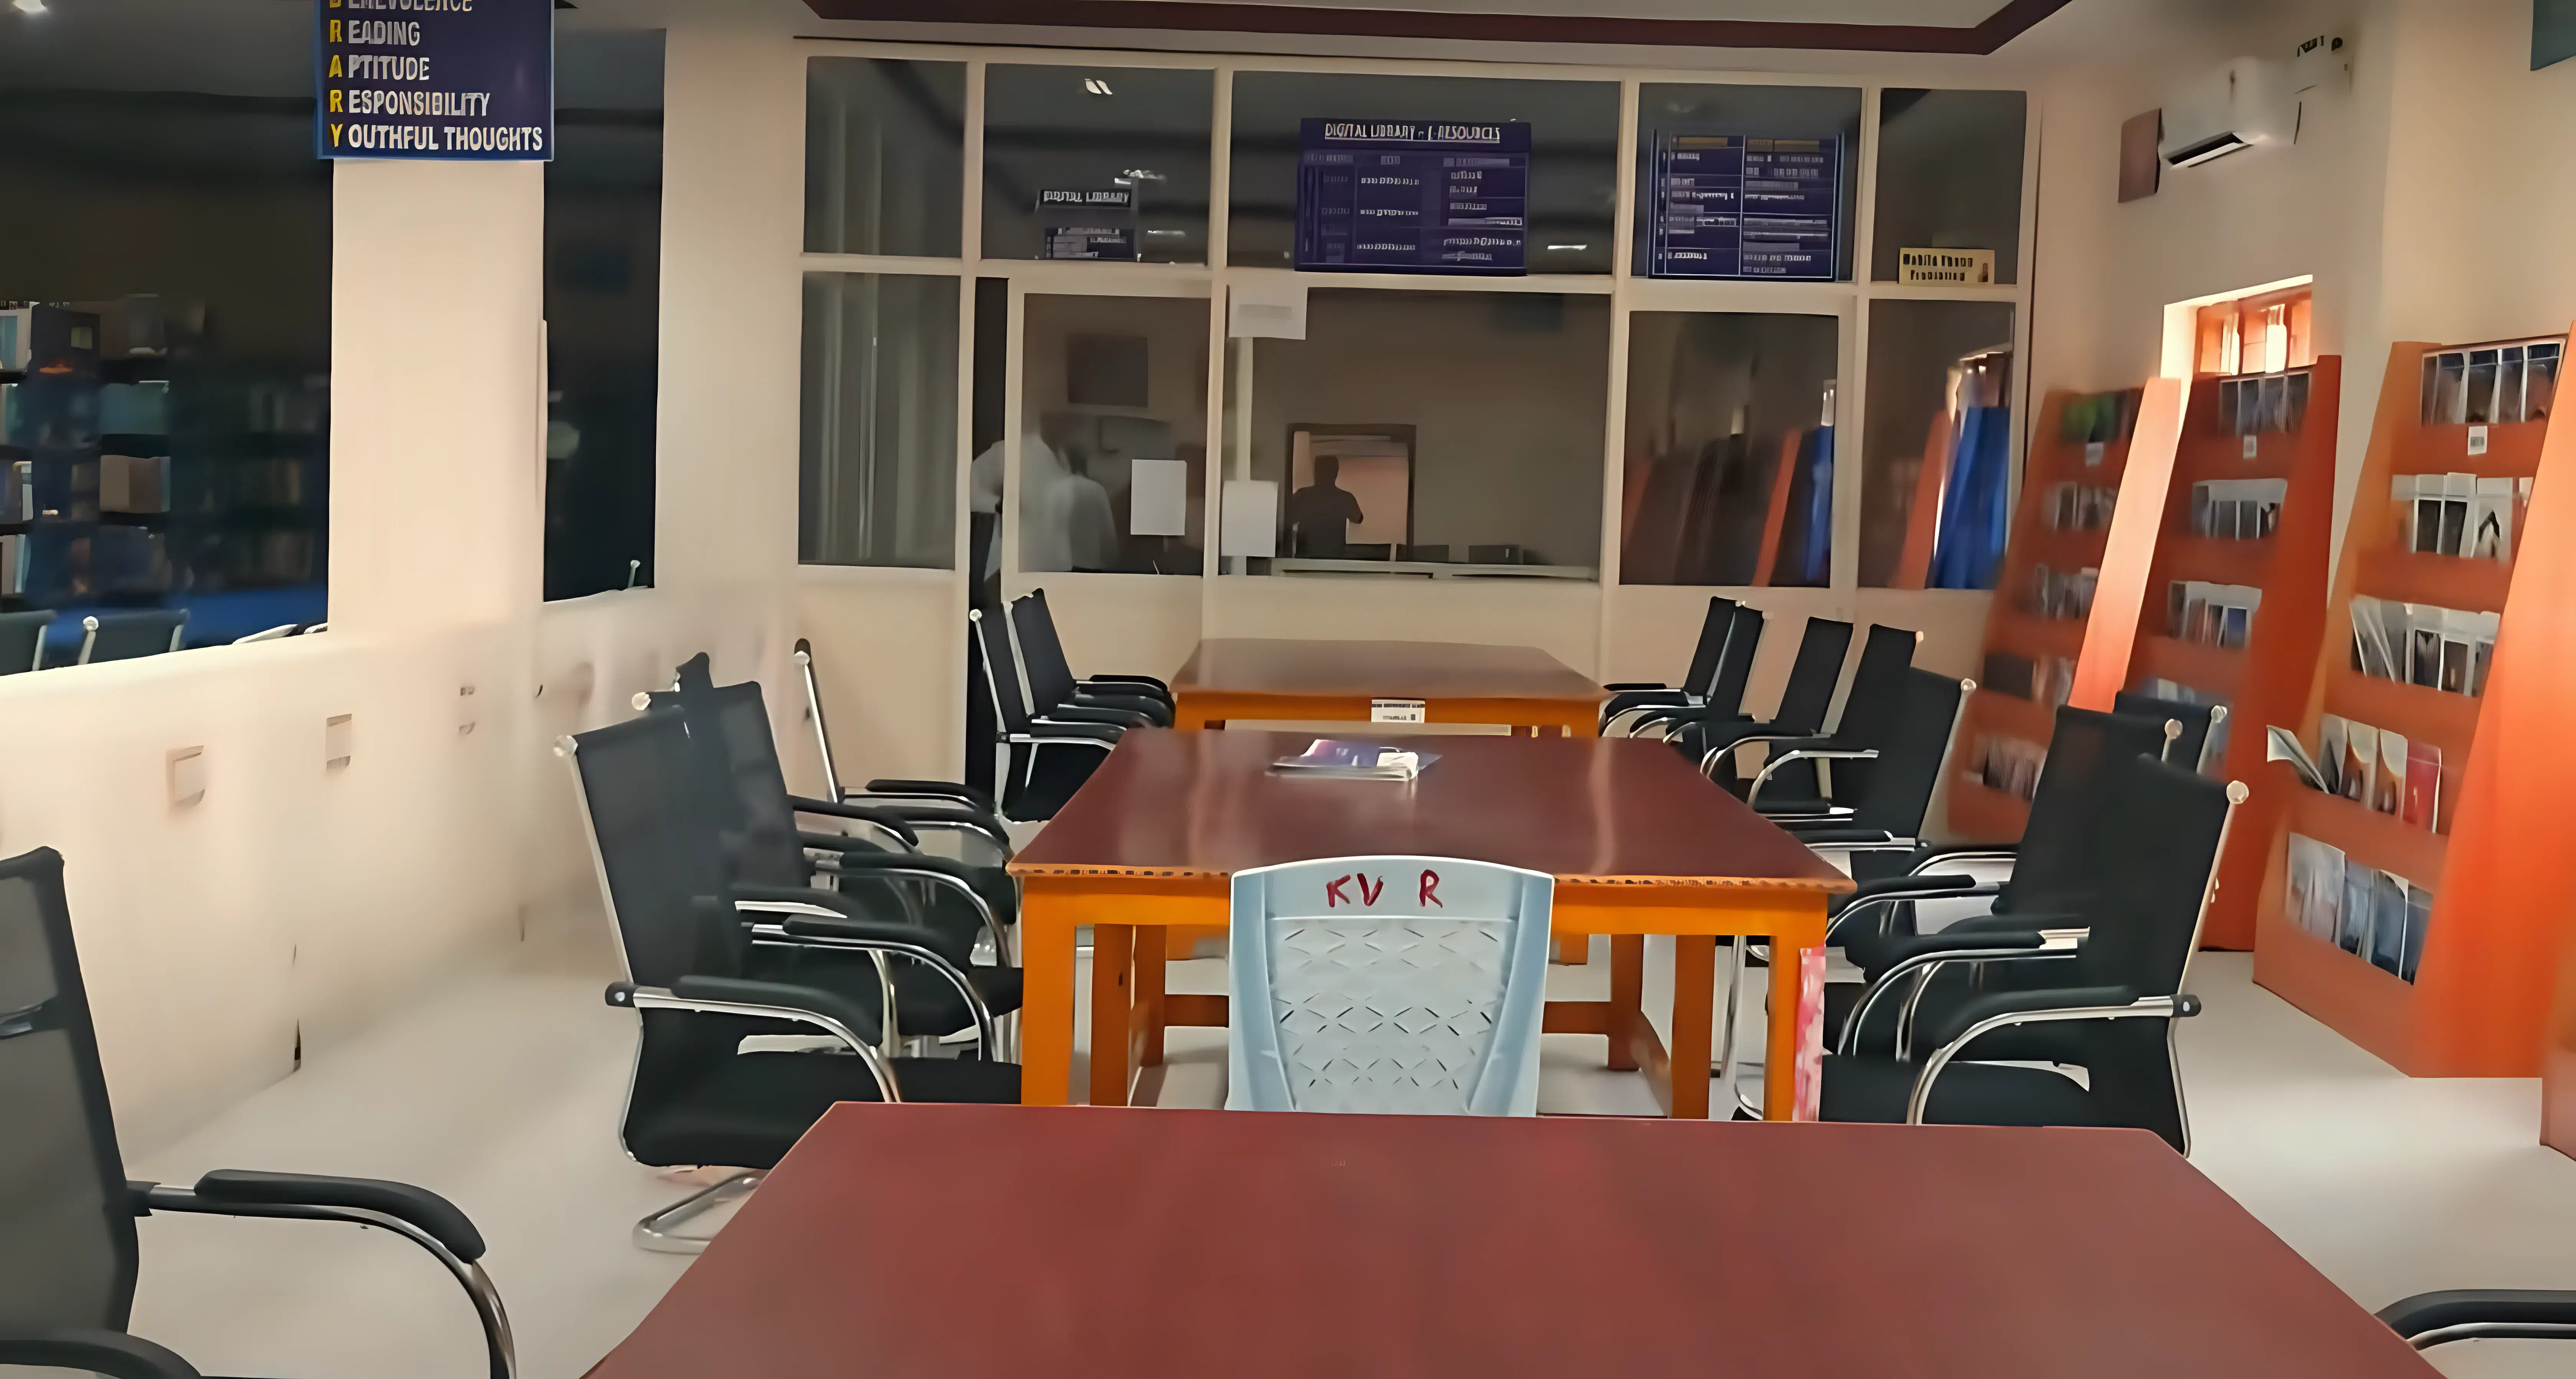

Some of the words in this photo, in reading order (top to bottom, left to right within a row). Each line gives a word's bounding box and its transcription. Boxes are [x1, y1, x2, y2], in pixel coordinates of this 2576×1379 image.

[444, 127, 543, 151] THOUGHTS
[1325, 123, 1367, 137] DIGITAL
[1371, 124, 1415, 140] LIBRARY
